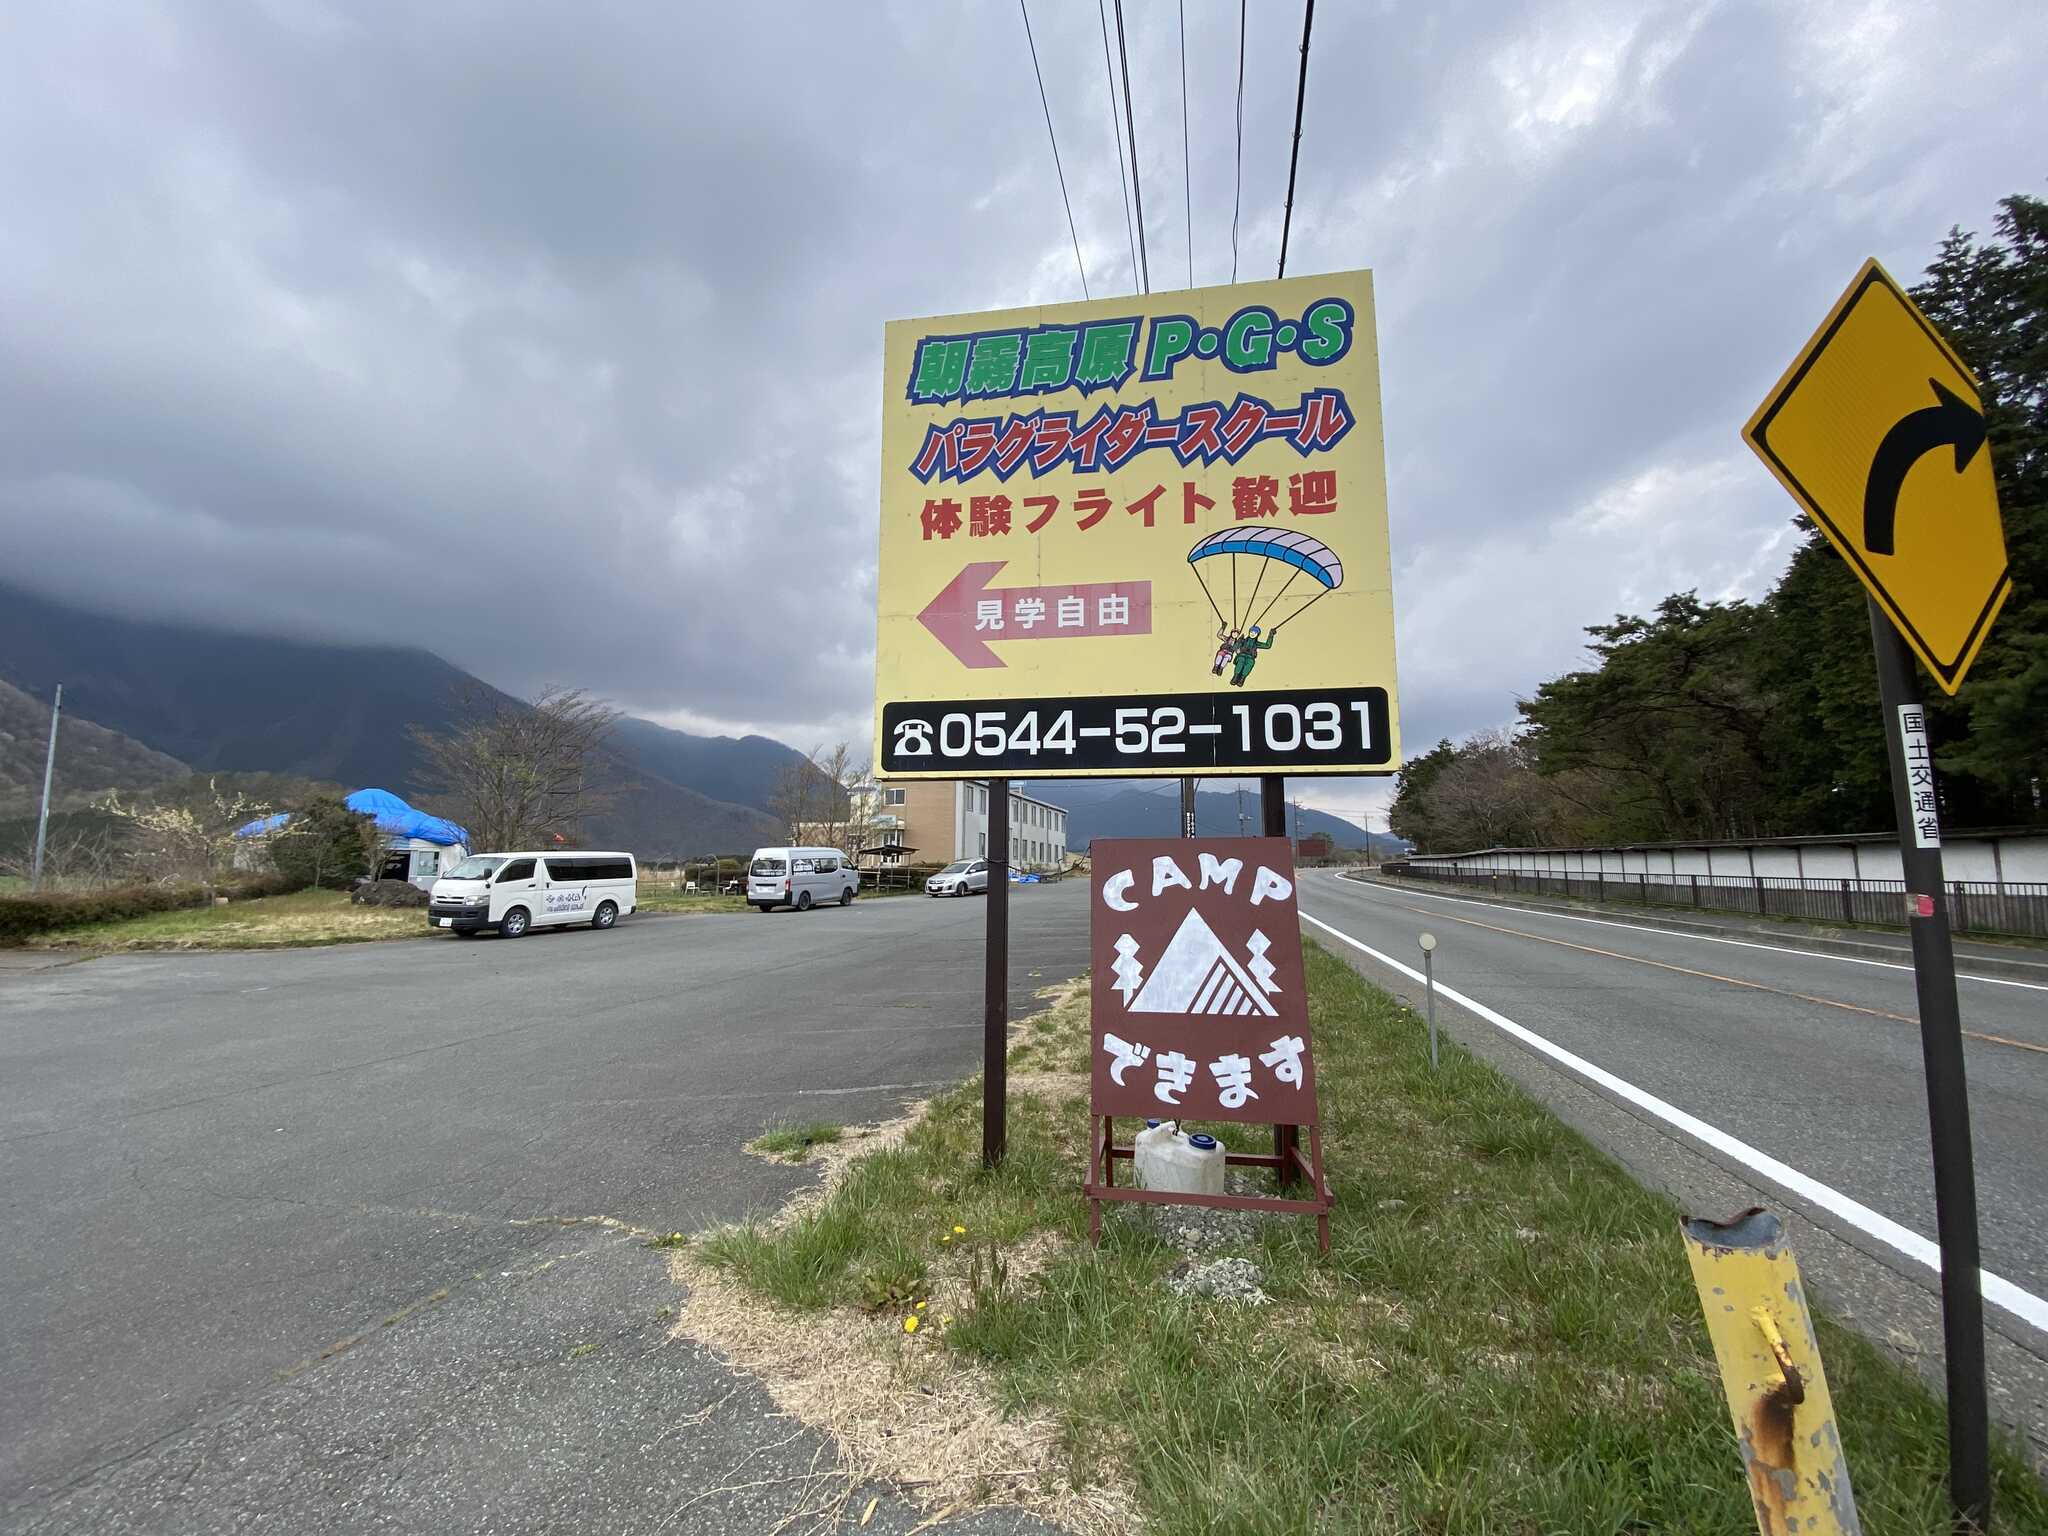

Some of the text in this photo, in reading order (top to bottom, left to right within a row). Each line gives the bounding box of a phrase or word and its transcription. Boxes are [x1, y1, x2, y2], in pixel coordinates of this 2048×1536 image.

[911, 321, 1137, 400] 朝霧高原
[916, 394, 1347, 476] パラグライダースクール
[920, 470, 1338, 541] 体験フライト歓迎
[974, 593, 1130, 631] 見学自由
[939, 700, 1372, 758] 0544-52-1031
[1903, 712, 1939, 840] 国土交通省
[1103, 852, 1293, 912] CAMP
[1103, 1032, 1306, 1109] できます
